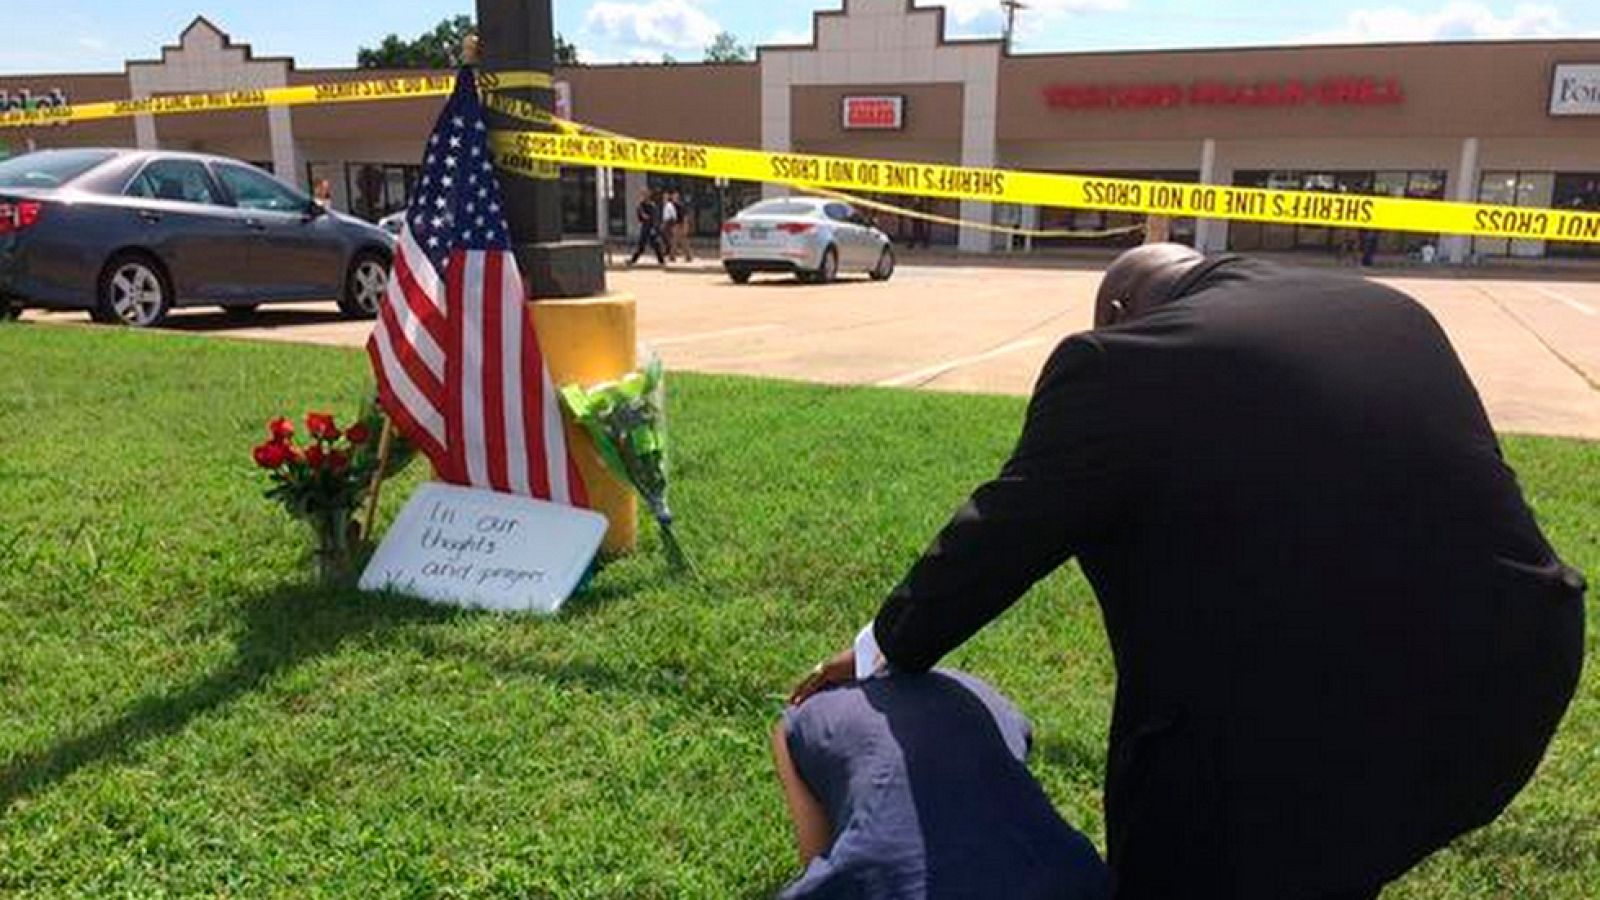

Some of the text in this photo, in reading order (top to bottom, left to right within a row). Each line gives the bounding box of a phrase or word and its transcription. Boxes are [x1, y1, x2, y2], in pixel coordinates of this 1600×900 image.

[609, 140, 638, 162] LINE
[771, 156, 1005, 195] SHERIFF'S LINE DO NOT CROSS
[1083, 181, 1373, 222] SHERIFF'S LINE DO NOT CROSS
[1475, 208, 1600, 238] NOT CROSS
[476, 514, 520, 533] our
[420, 560, 473, 581] and
